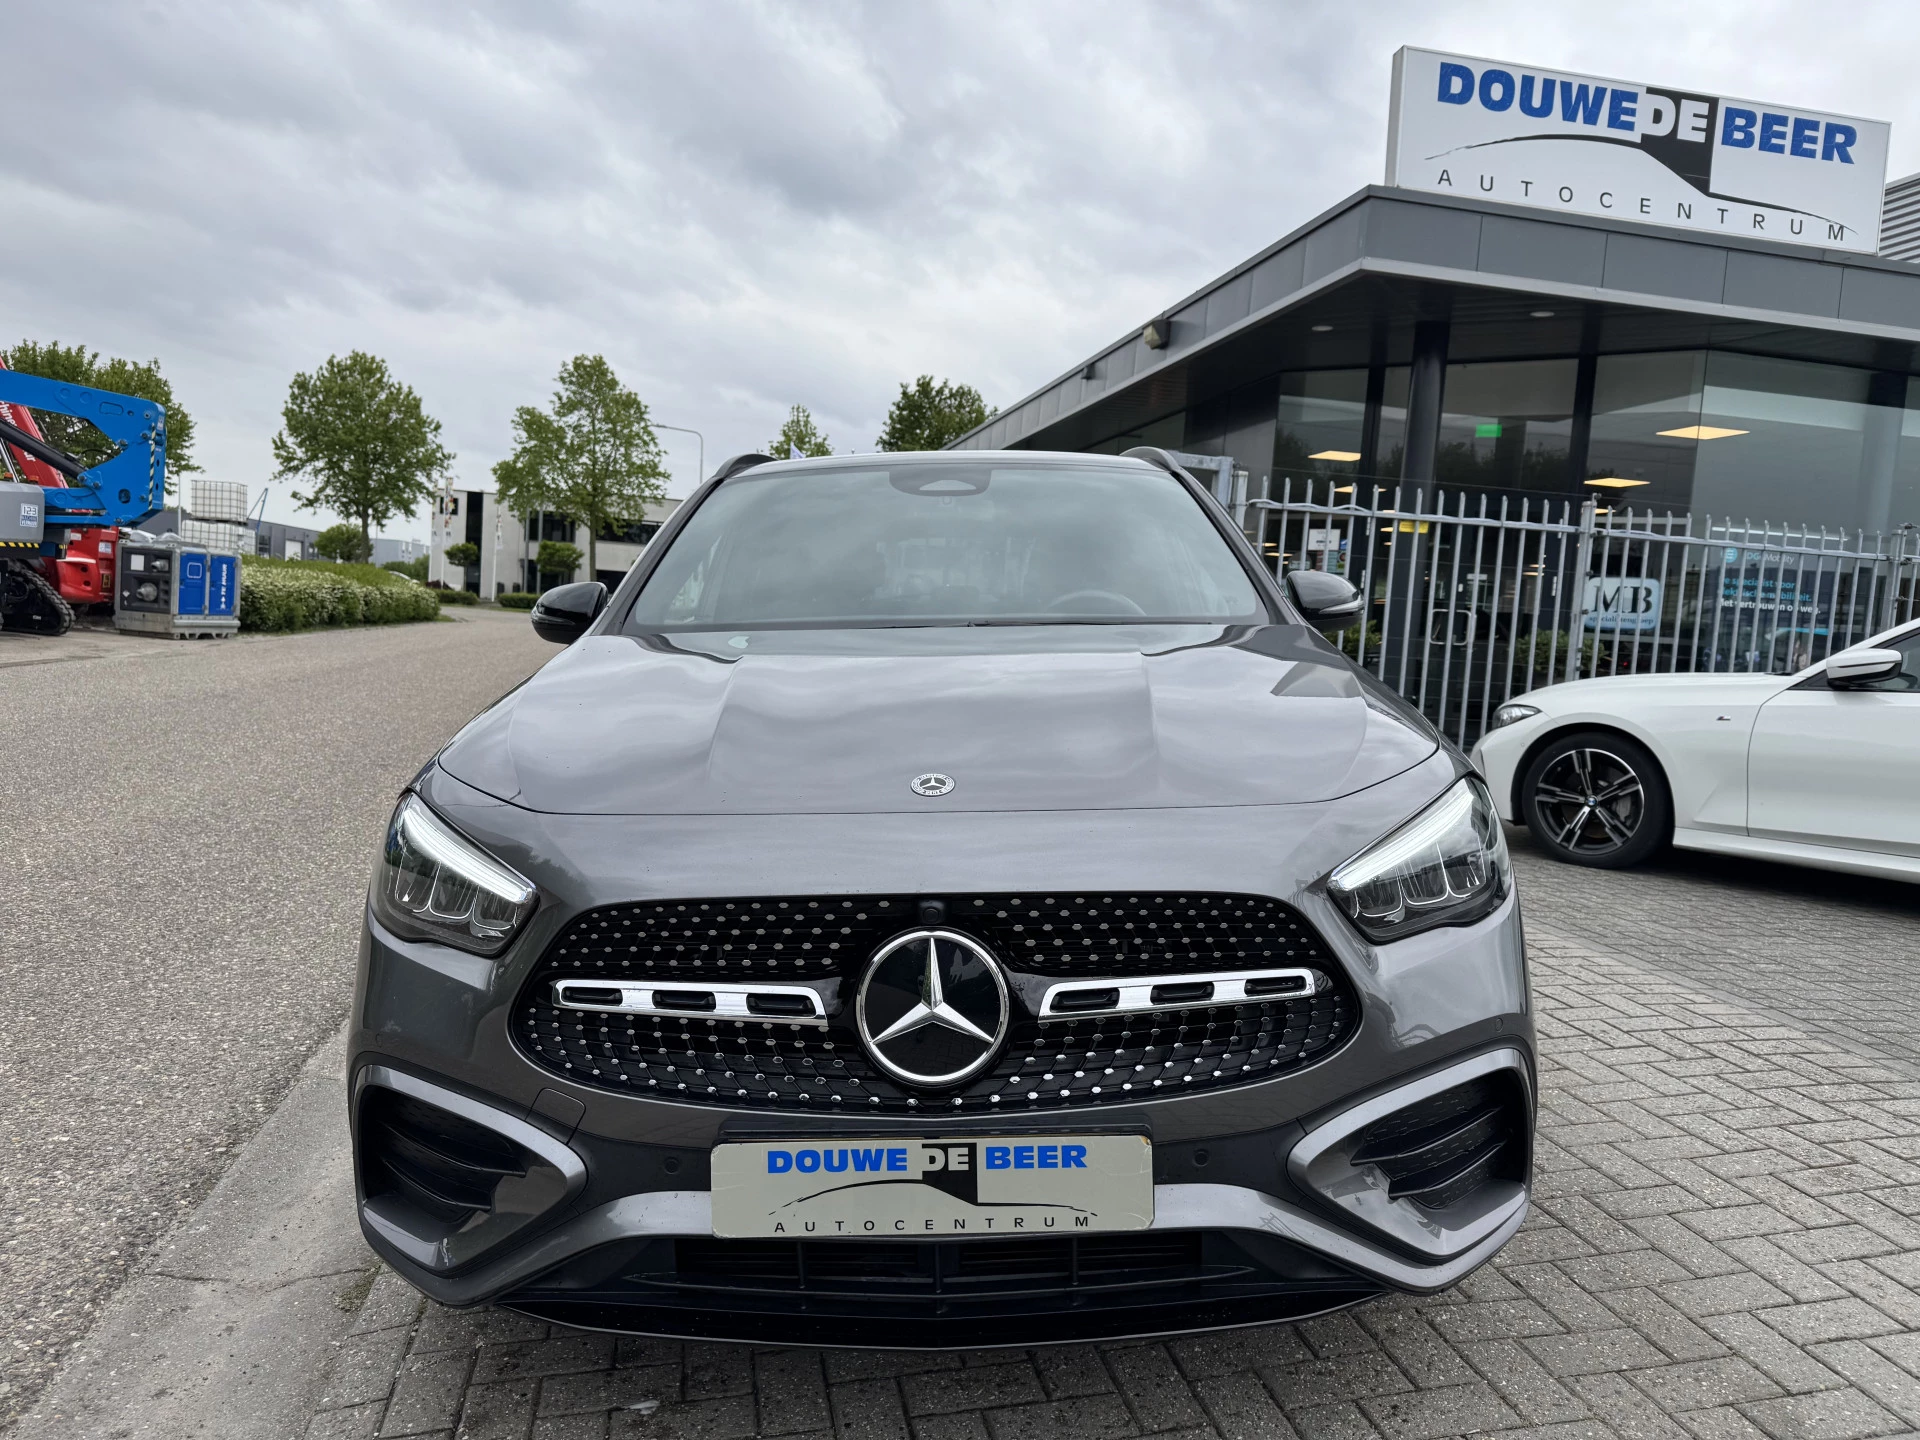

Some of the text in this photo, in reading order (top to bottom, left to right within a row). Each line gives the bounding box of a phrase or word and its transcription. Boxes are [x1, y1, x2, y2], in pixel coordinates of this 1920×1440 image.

[1437, 61, 1858, 165] DOUWE DE BEER
[1437, 168, 1845, 242] AUTOCENTRUM
[1591, 585, 1653, 613] MB
[767, 1144, 1088, 1174] DOUWE DE BEER
[773, 1215, 1090, 1234] AUTOCENTRUM
